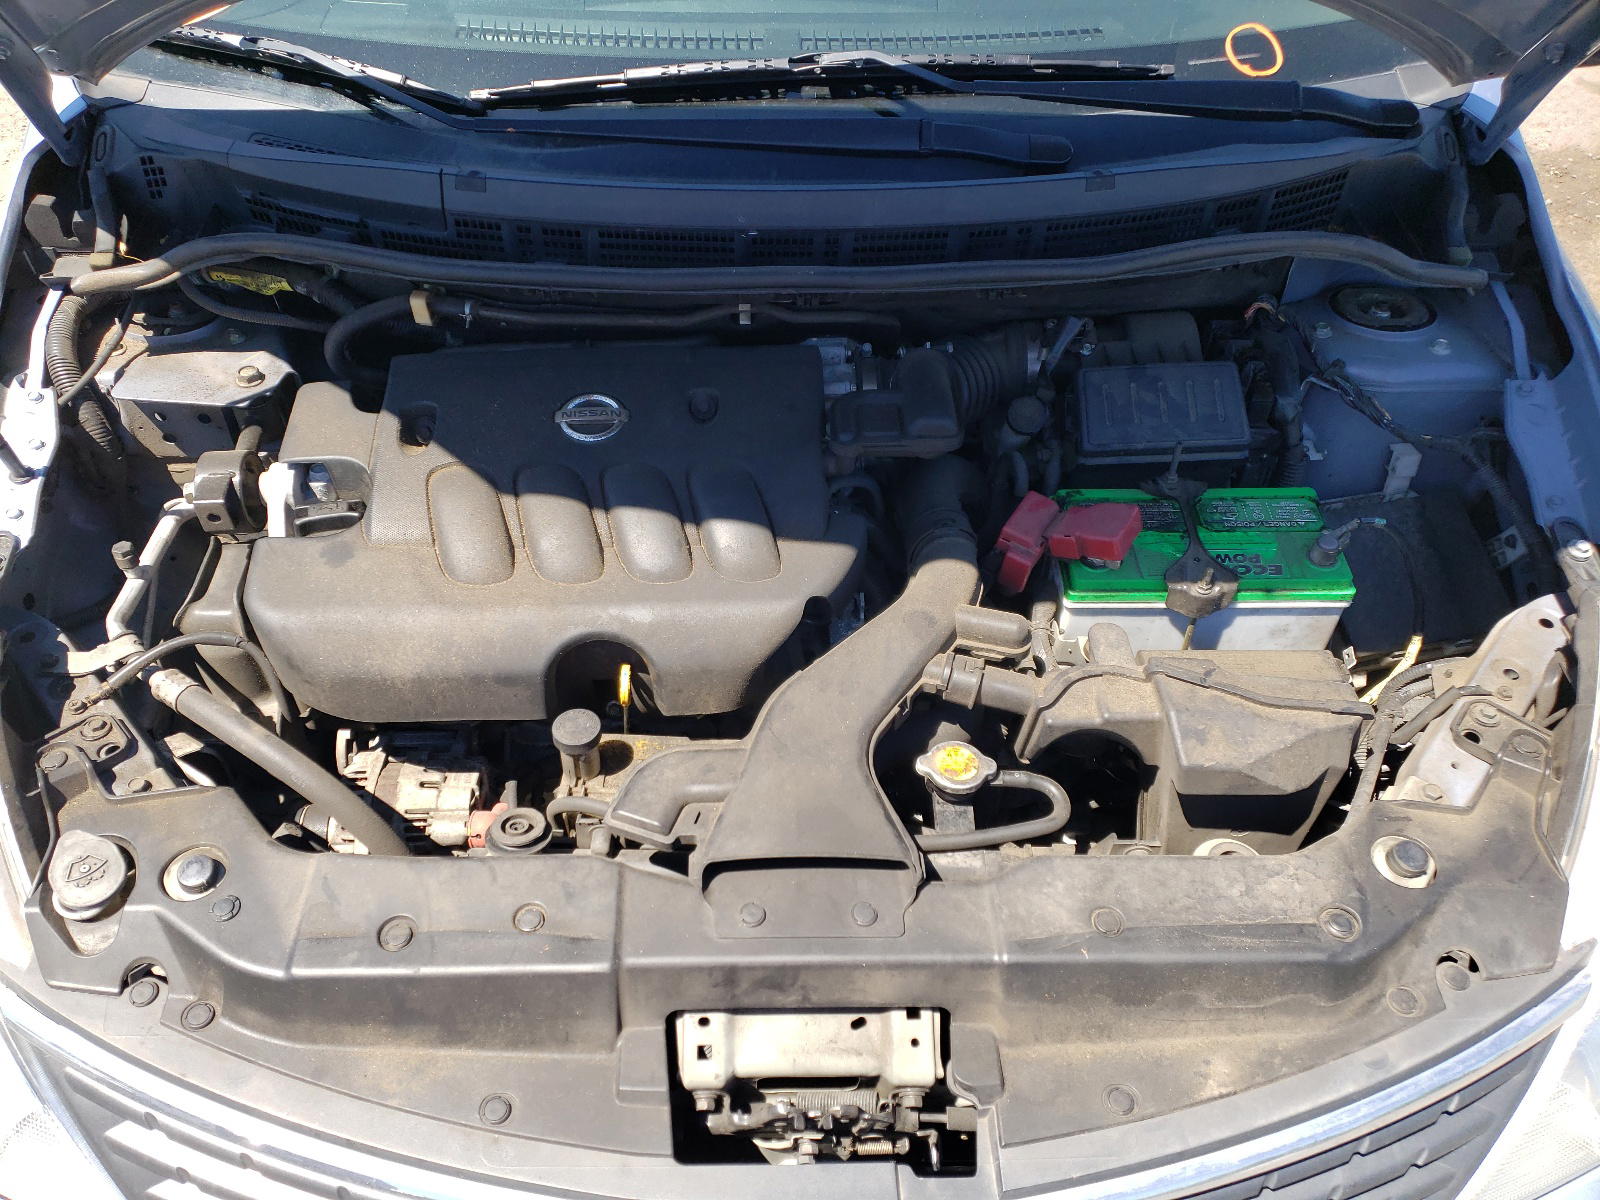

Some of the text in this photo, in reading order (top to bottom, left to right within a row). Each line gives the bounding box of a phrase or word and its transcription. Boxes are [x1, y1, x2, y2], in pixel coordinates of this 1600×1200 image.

[562, 409, 621, 418] NISSAN
[1215, 553, 1261, 563] POW
[1233, 564, 1283, 576] ECO
